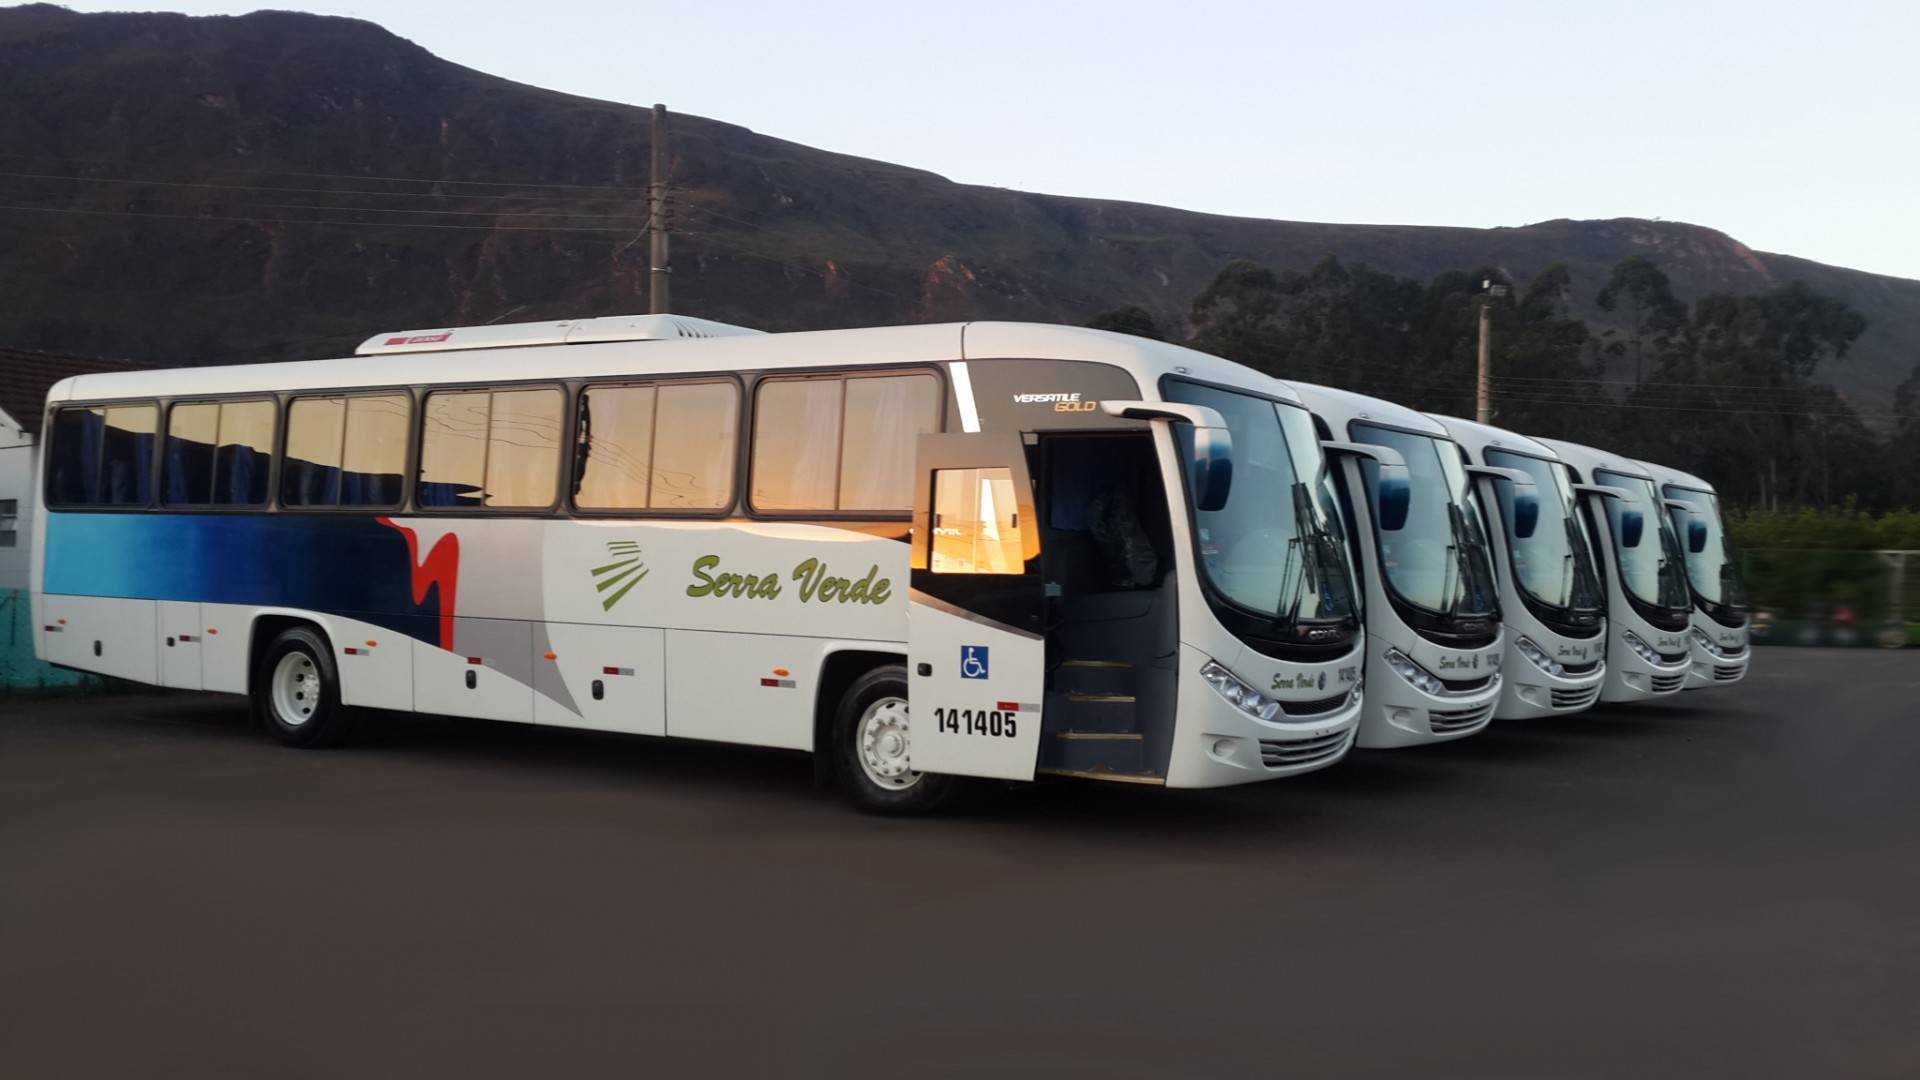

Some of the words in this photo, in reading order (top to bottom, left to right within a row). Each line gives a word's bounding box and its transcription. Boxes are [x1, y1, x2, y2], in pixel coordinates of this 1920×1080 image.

[1013, 393, 1081, 403] VERSATILE
[1054, 401, 1097, 412] GOLD
[686, 555, 782, 600] Serra
[793, 557, 892, 605] Verde
[1271, 672, 1294, 690] Serra
[934, 707, 1017, 738] 141405
